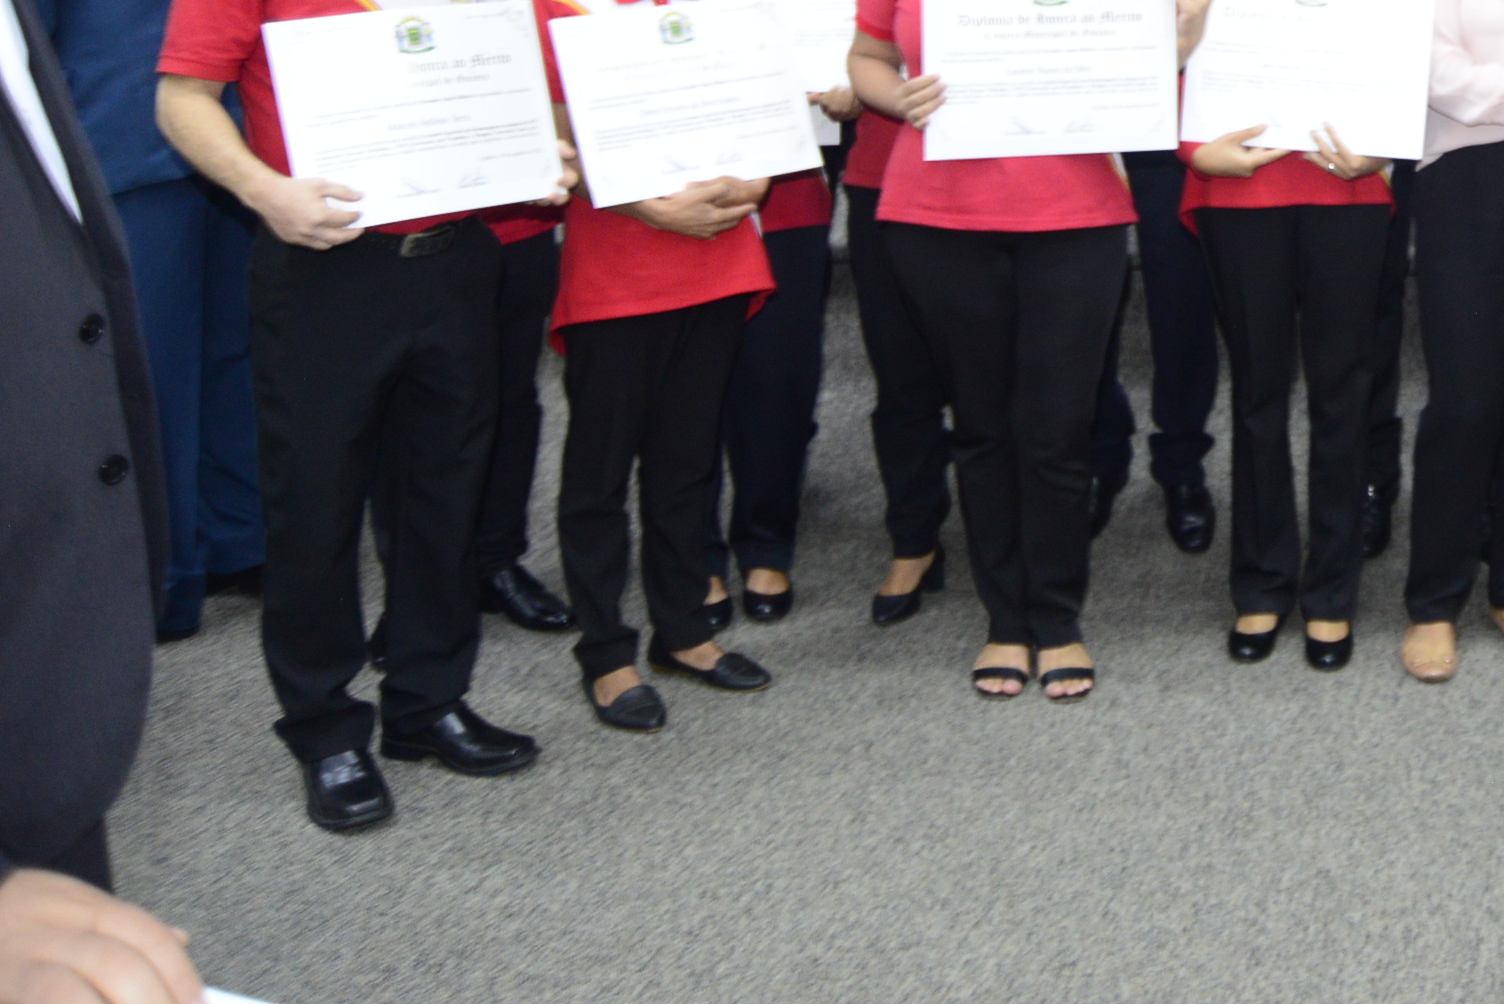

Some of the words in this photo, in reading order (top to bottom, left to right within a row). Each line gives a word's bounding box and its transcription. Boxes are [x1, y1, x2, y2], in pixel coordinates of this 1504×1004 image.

[958, 14, 1013, 27] Diploma
[1018, 14, 1030, 25] de
[1036, 12, 1077, 25] Honra
[1081, 14, 1095, 24] ao
